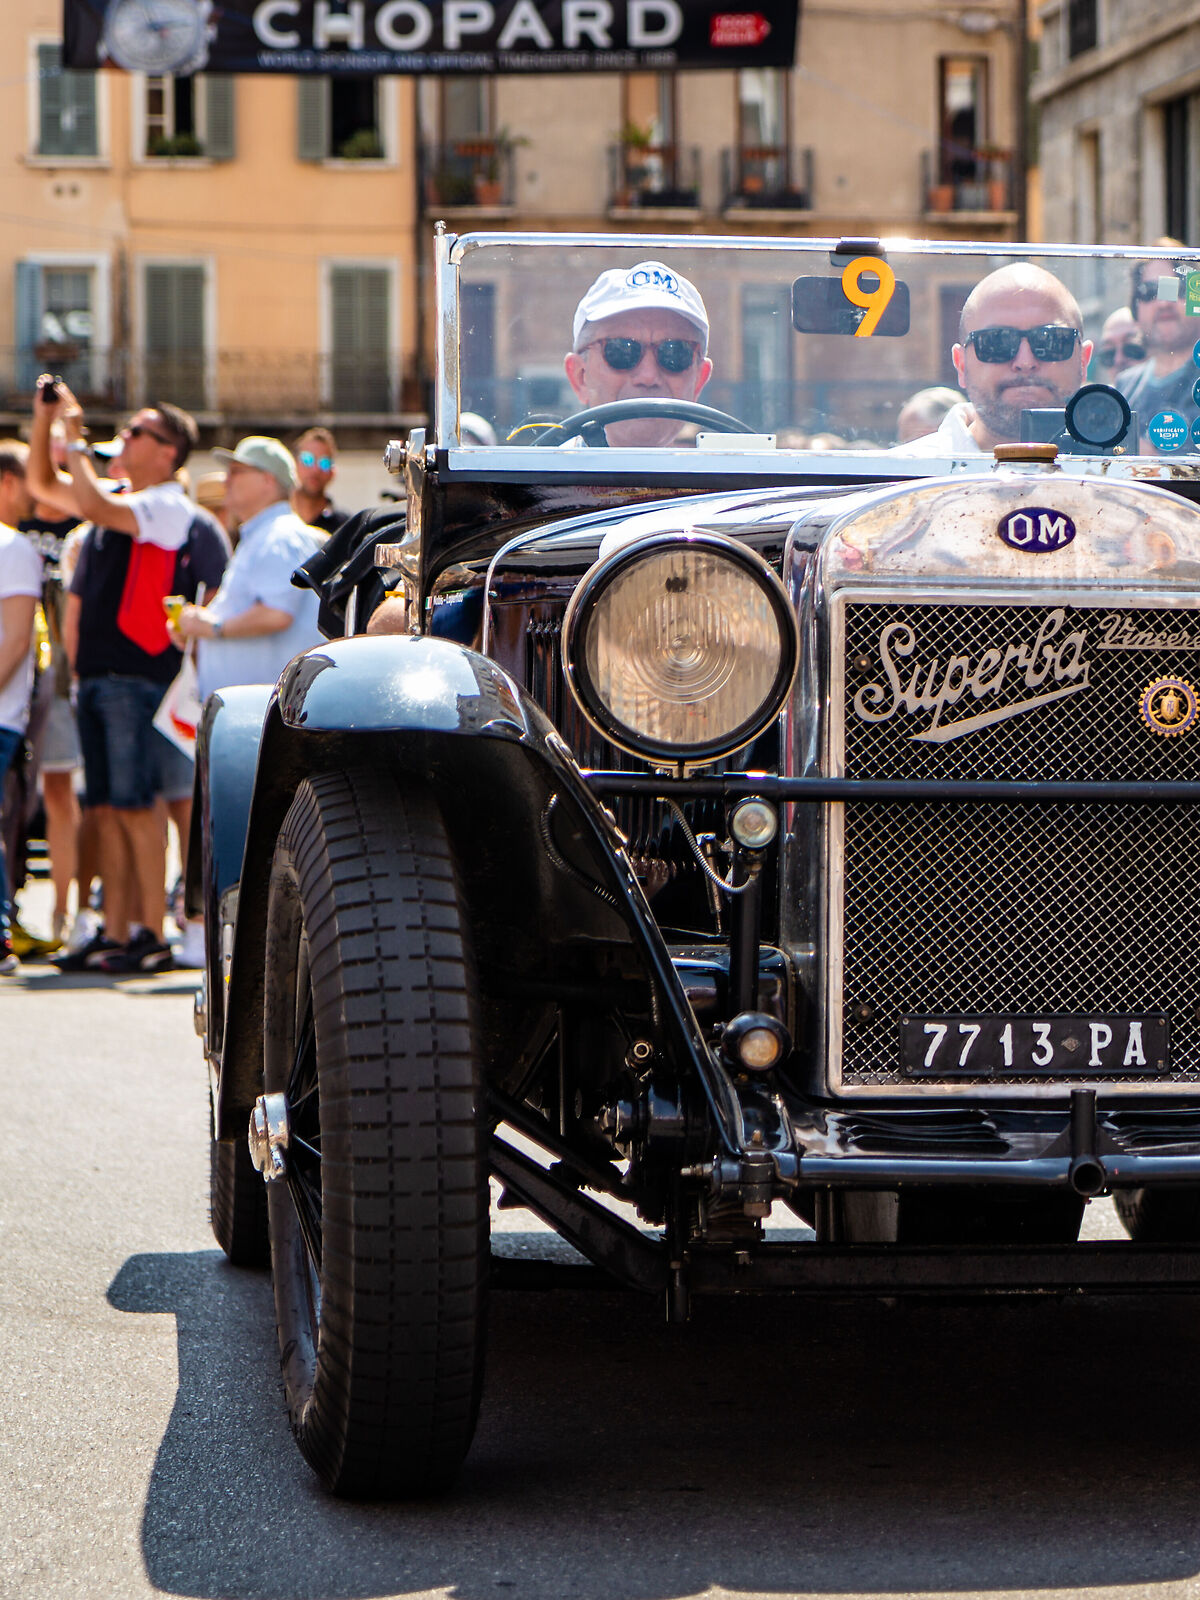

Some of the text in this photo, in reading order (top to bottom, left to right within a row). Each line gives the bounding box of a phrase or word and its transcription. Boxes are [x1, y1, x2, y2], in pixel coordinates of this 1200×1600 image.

[252, 0, 684, 50] CHOPARD
[632, 270, 672, 289] OM
[842, 256, 895, 337] 9
[1007, 512, 1067, 546] OM
[853, 608, 1091, 735] Superba
[923, 1021, 1147, 1067] 7713 PA
